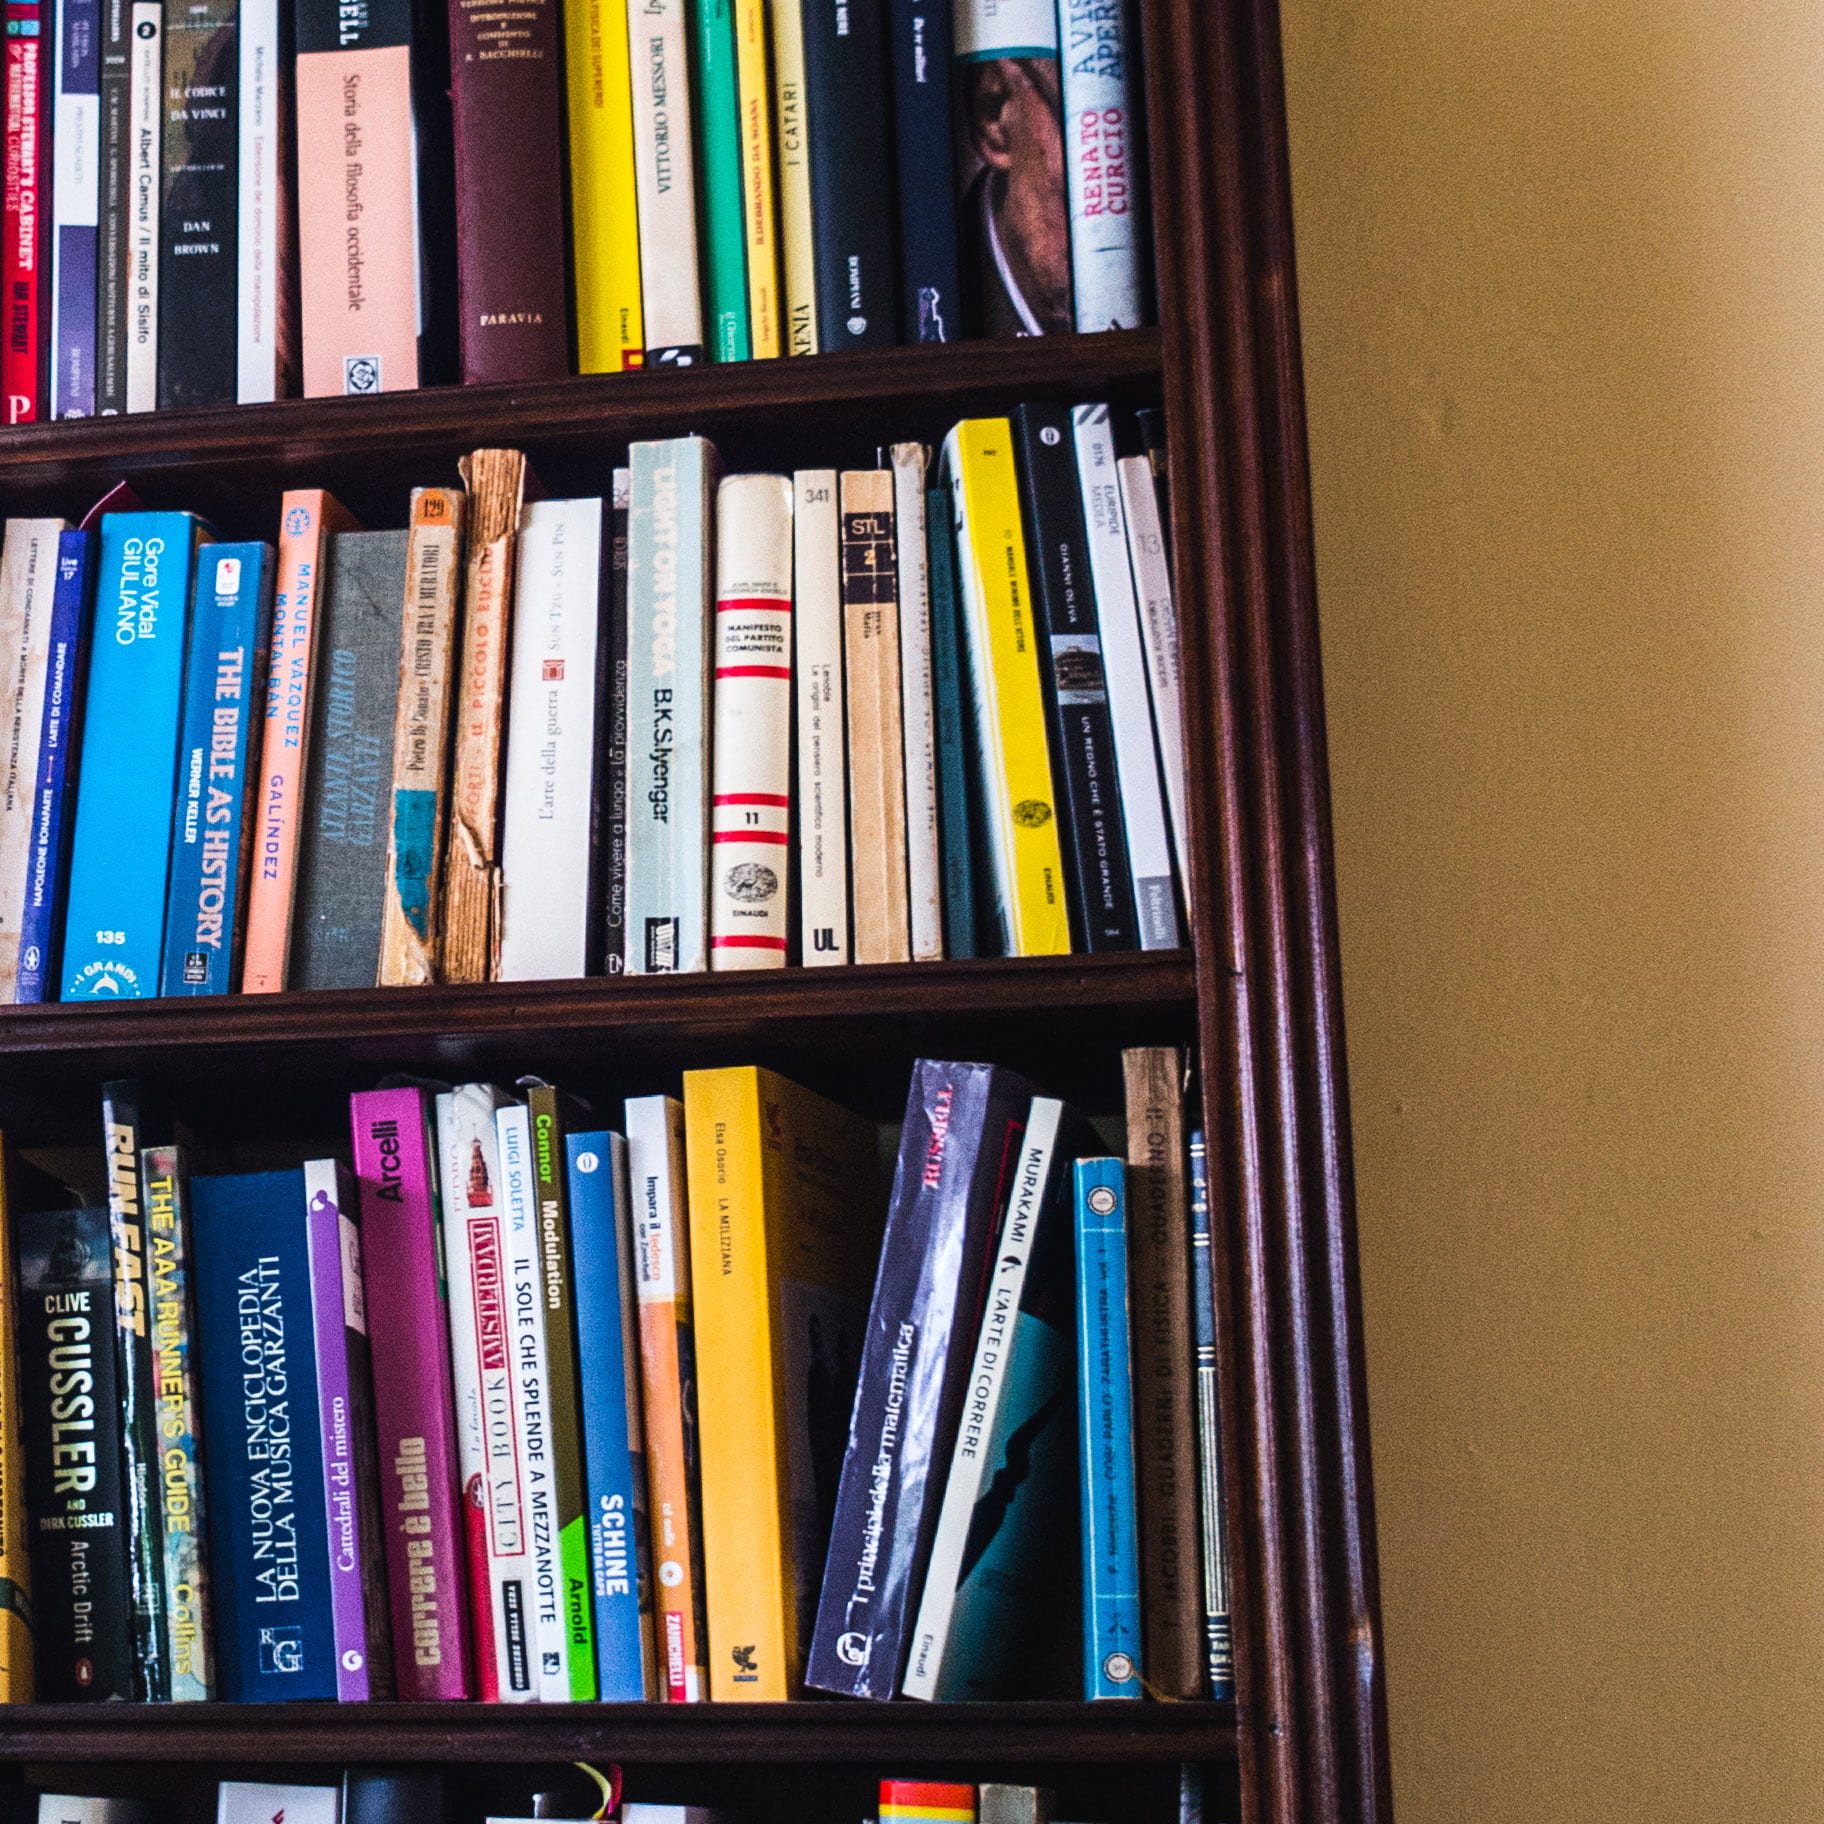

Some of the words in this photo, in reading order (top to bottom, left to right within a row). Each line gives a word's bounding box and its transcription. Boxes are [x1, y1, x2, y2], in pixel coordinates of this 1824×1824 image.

[170, 108, 189, 122] DA
[190, 107, 227, 121] VINCI
[184, 84, 227, 99] CODICE
[343, 74, 361, 117] Storia
[138, 128, 153, 170] Albert
[344, 123, 362, 157] della
[1079, 110, 1104, 217] RENATO
[1102, 107, 1130, 215] CURCIO
[5, 136, 20, 212] CURIOSITIES
[137, 174, 152, 222] Camus
[345, 161, 364, 222] filosofia
[173, 243, 220, 256] BROWN
[182, 221, 211, 234] DAN
[137, 250, 151, 282] mito
[345, 226, 364, 312] occidentale
[848, 255, 862, 309] BOMPIANI
[136, 286, 151, 300] di
[479, 312, 543, 326] PARAVIA
[136, 303, 151, 345] Sisifo
[619, 307, 631, 343] Einaudi
[141, 537, 164, 588] Gore
[1058, 543, 1073, 585] GIANNI
[114, 537, 143, 646] GIULIANO
[138, 590, 161, 639] Vidal
[1064, 588, 1077, 624] OLIVA
[51, 641, 68, 706] COMANDARE
[214, 646, 245, 701] THE
[471, 623, 490, 710] PICCOLO
[47, 718, 61, 748] L'ARTE
[208, 707, 240, 781] BIBLE
[187, 747, 204, 798] WERNER
[37, 788, 54, 845] BONAPARTE
[184, 799, 200, 844] KELLER
[205, 786, 234, 824] AS
[262, 774, 287, 881] GALÍNDEZ
[744, 812, 759, 825] 11
[32, 846, 48, 907] NAPOLEONE
[194, 829, 232, 950] HISTORY
[95, 930, 126, 945] 135
[505, 1126, 525, 1164] LUIGI
[714, 1122, 728, 1146] Elsa
[106, 1122, 139, 1217] RUN
[371, 1119, 404, 1203] Arcelli
[715, 1148, 729, 1184] Osorio
[148, 1176, 176, 1233] THE
[508, 1168, 527, 1232] SOLETTA
[644, 1176, 662, 1220] Impara
[717, 1197, 731, 1211] LA
[1009, 1147, 1045, 1243] MURAKAMI
[151, 1236, 179, 1297] AAA
[513, 1257, 533, 1277] IL
[541, 1199, 564, 1310] Modulation
[649, 1233, 665, 1281] tedesco
[718, 1214, 733, 1277] MILIZIANA
[43, 1292, 92, 1313] CLIVE
[113, 1220, 146, 1338] FAST
[515, 1281, 535, 1329] SOLE
[257, 1256, 287, 1397] GARZANTI
[983, 1286, 1012, 1347] L'ARTE
[155, 1301, 185, 1438] RUNNER'S
[236, 1268, 271, 1460] ENCICLOPEDIA
[517, 1333, 539, 1373] CHE
[980, 1351, 998, 1370] DI
[46, 1316, 97, 1495] CUSSLER
[328, 1396, 348, 1457] mistero
[520, 1377, 544, 1461] SPLENDE
[960, 1373, 992, 1459] CORRERE
[267, 1400, 295, 1505] MUSICA
[329, 1461, 350, 1486] del
[394, 1436, 429, 1511] bello
[527, 1470, 547, 1485] A
[135, 1462, 149, 1509] Higdon
[162, 1448, 191, 1534] GUIDE
[661, 1502, 675, 1516] cd
[66, 1513, 115, 1529] CUSSLER
[248, 1469, 275, 1560] NUOVA
[332, 1490, 357, 1572] Cattedrali
[398, 1513, 432, 1535] è
[662, 1518, 677, 1547] audio
[68, 1540, 92, 1596] Arctic
[271, 1511, 301, 1601] DELLA
[530, 1490, 556, 1624] MEZZANOTTE
[598, 1493, 630, 1597] SCHINE
[252, 1566, 277, 1602] LA
[403, 1540, 442, 1666] correre
[72, 1600, 94, 1644] Drift
[172, 1583, 198, 1676] Collins
